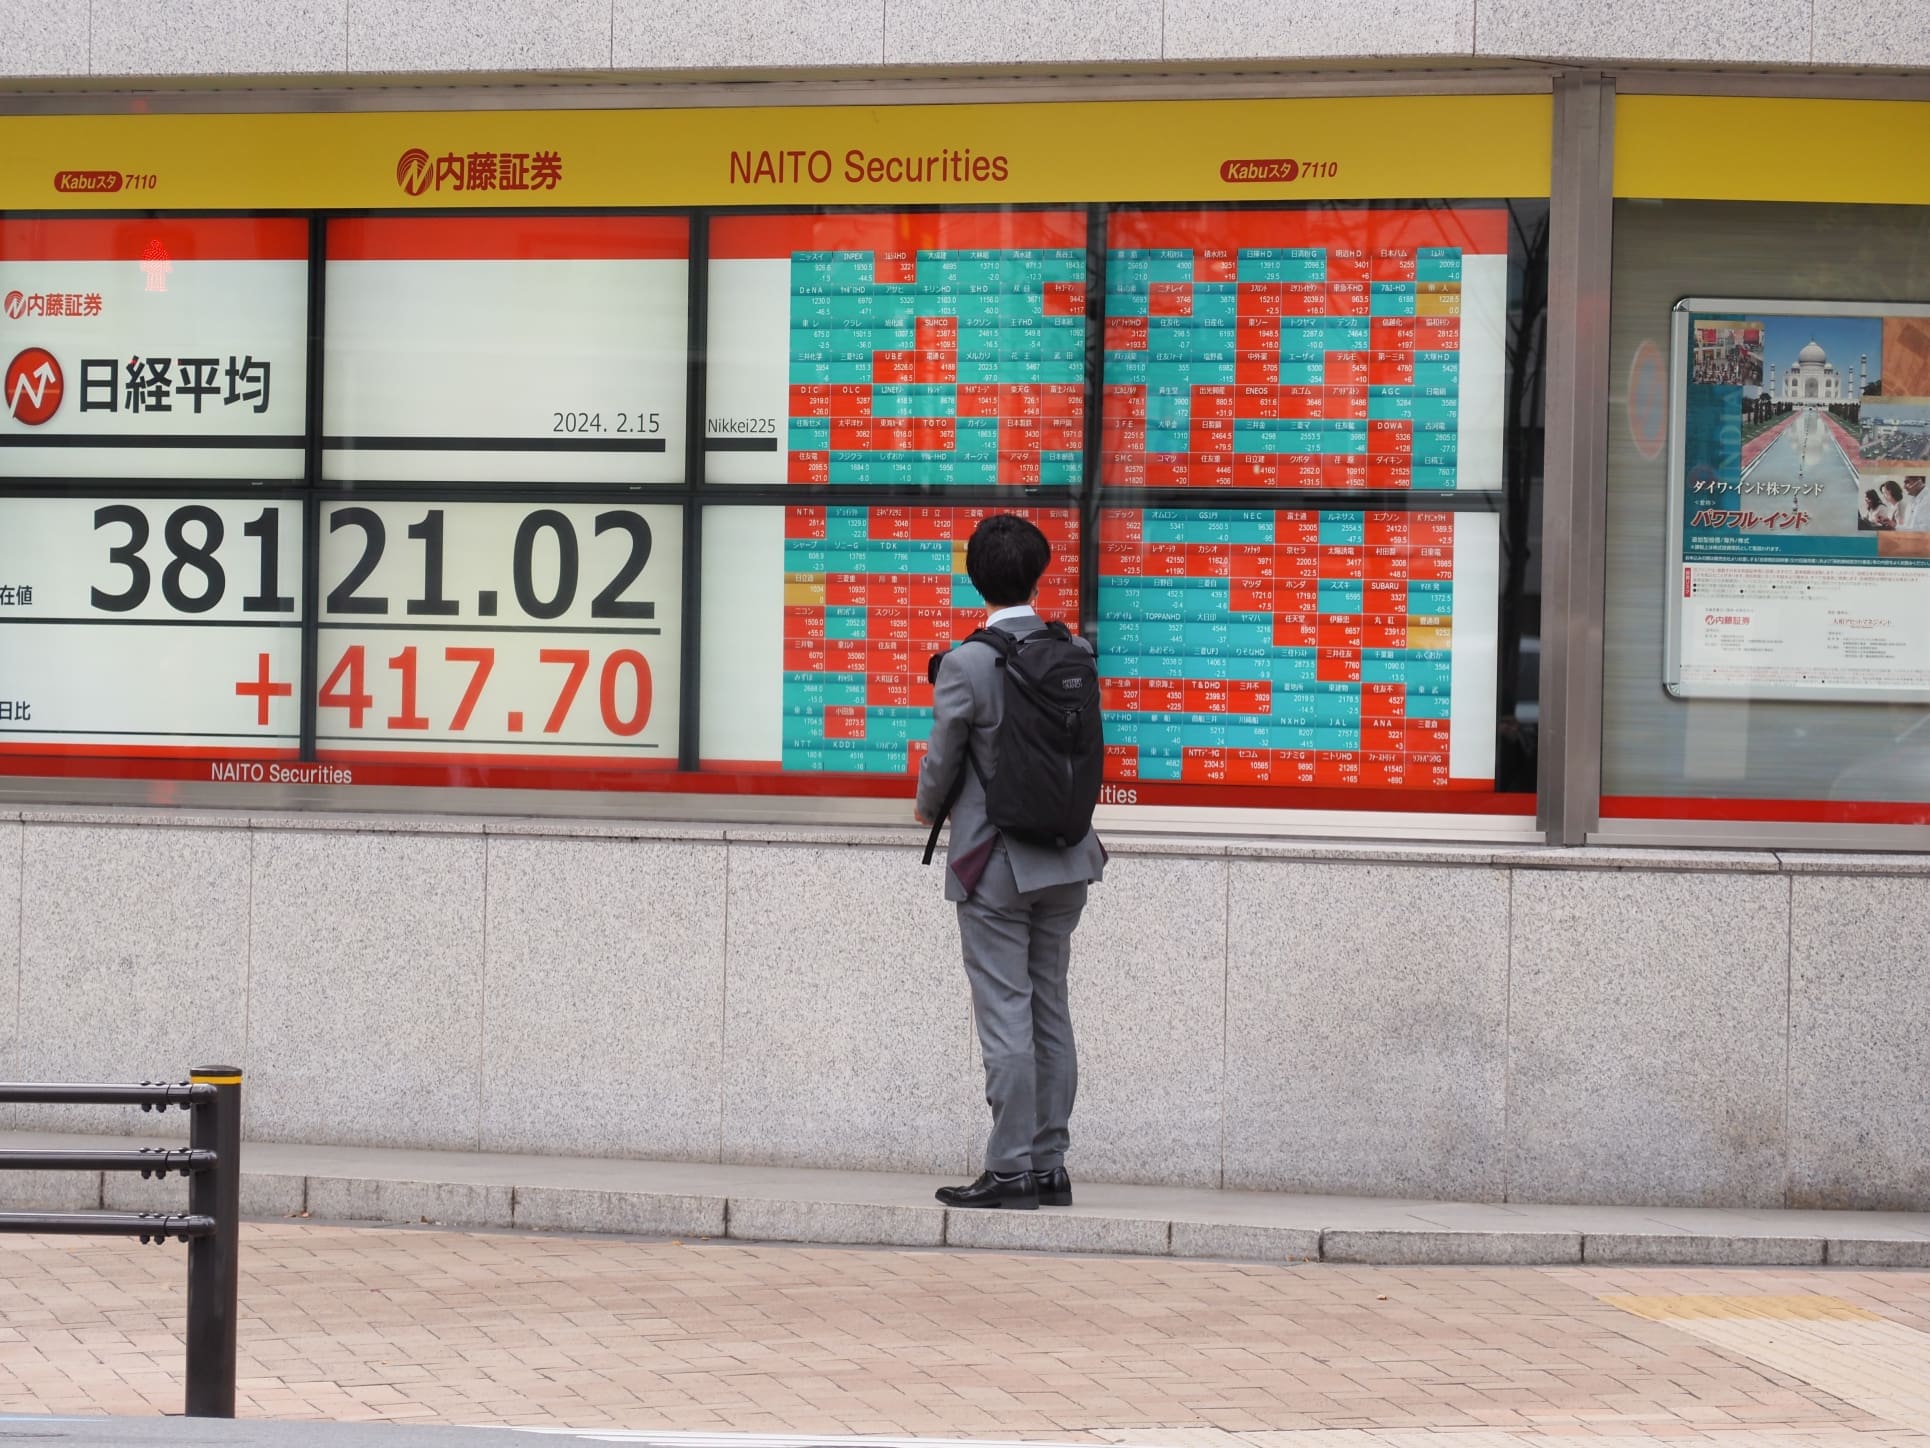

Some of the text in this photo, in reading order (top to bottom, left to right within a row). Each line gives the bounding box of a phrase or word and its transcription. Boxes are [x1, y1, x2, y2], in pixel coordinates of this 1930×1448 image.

[730, 149, 1009, 184] NAITO Securities
[1228, 161, 1338, 180] Kabuスタ 7110
[435, 152, 562, 191] 内藤証券
[60, 173, 157, 191] Kabuスタ 7110
[799, 286, 823, 294] DeNA
[27, 293, 103, 317] 内藤証券
[967, 319, 991, 327] ネクソン
[1291, 319, 1316, 327] トクヤマ
[1339, 318, 1358, 326] デンカ
[885, 352, 903, 360] UBE
[966, 352, 990, 360] メルカリ
[80, 355, 271, 414] 日経平均
[801, 386, 819, 394] DIC
[842, 386, 860, 394] OLC
[1245, 387, 1268, 395] ENEOS
[1382, 387, 1400, 395] AGC
[553, 412, 660, 434] 2024. 2.15
[708, 417, 775, 433] Nikkei225
[923, 419, 947, 427] TOTO
[968, 419, 986, 428] ガイシ
[1377, 422, 1403, 430] DOWA
[964, 453, 989, 461] オークマ
[1010, 453, 1029, 461] アマダ
[1290, 455, 1310, 463] クボタ
[1376, 456, 1402, 464] ダイキン
[1693, 480, 1824, 496] ダイワ・インド株ファンド
[796, 508, 814, 516] NTN
[1152, 511, 1177, 519] オムロン
[1243, 512, 1262, 520] NEC
[1374, 513, 1400, 521] エプソン
[1691, 509, 1810, 531] パワフル・インド
[880, 542, 897, 550] TDK
[1107, 544, 1134, 552] デンソー
[1198, 545, 1217, 553] カシオ
[1286, 546, 1306, 554] 京セラ
[90, 504, 655, 619] 38121.02
[1111, 578, 1130, 586] トヨタ
[1242, 580, 1262, 588] マツダ
[1286, 580, 1306, 588] ホンダ
[1331, 581, 1349, 590] スズキ
[1371, 582, 1399, 590] SUBARU
[795, 607, 814, 615] ニコン
[918, 609, 942, 617] HOYA
[1109, 646, 1128, 654] イオン
[235, 645, 653, 737] +417.70
[1330, 718, 1346, 727] JAL
[1373, 719, 1392, 727] ANA
[794, 740, 811, 748] NTT
[833, 740, 855, 749] KDDI
[1238, 750, 1258, 758] セコム
[211, 762, 352, 784] NAITO Securities
